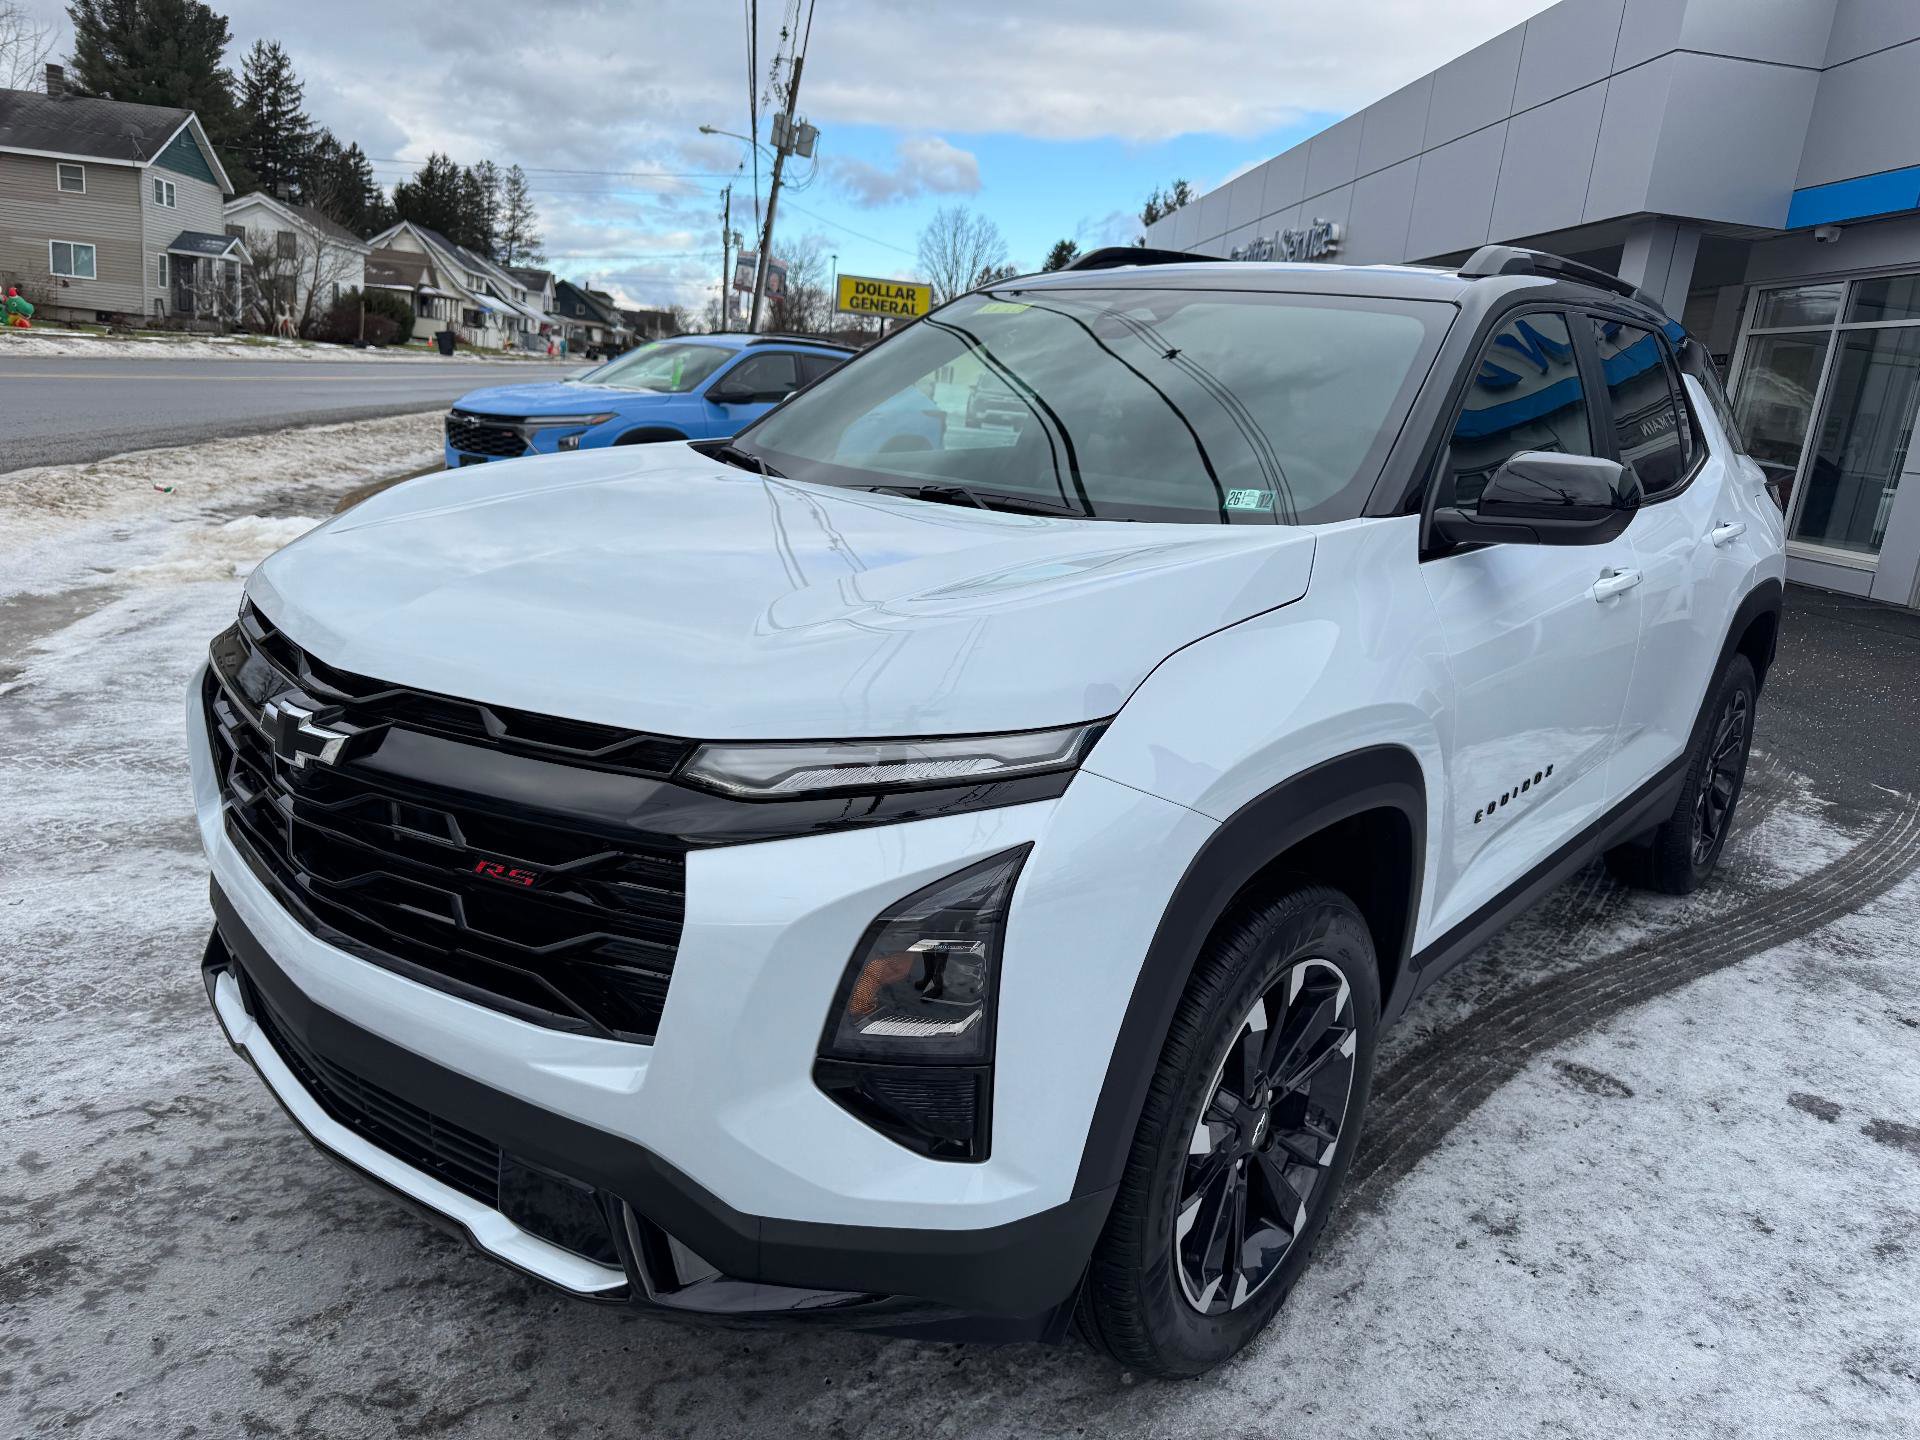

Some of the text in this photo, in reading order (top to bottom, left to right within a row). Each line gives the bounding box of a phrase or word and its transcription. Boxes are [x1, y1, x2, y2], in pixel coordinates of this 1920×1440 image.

[1281, 217, 1339, 263] Service
[855, 281, 916, 301] DOLLAR
[849, 296, 919, 315] GENERAL
[1228, 491, 1242, 506] 26
[1474, 764, 1553, 824] EQUINOX
[475, 860, 537, 888] RS
